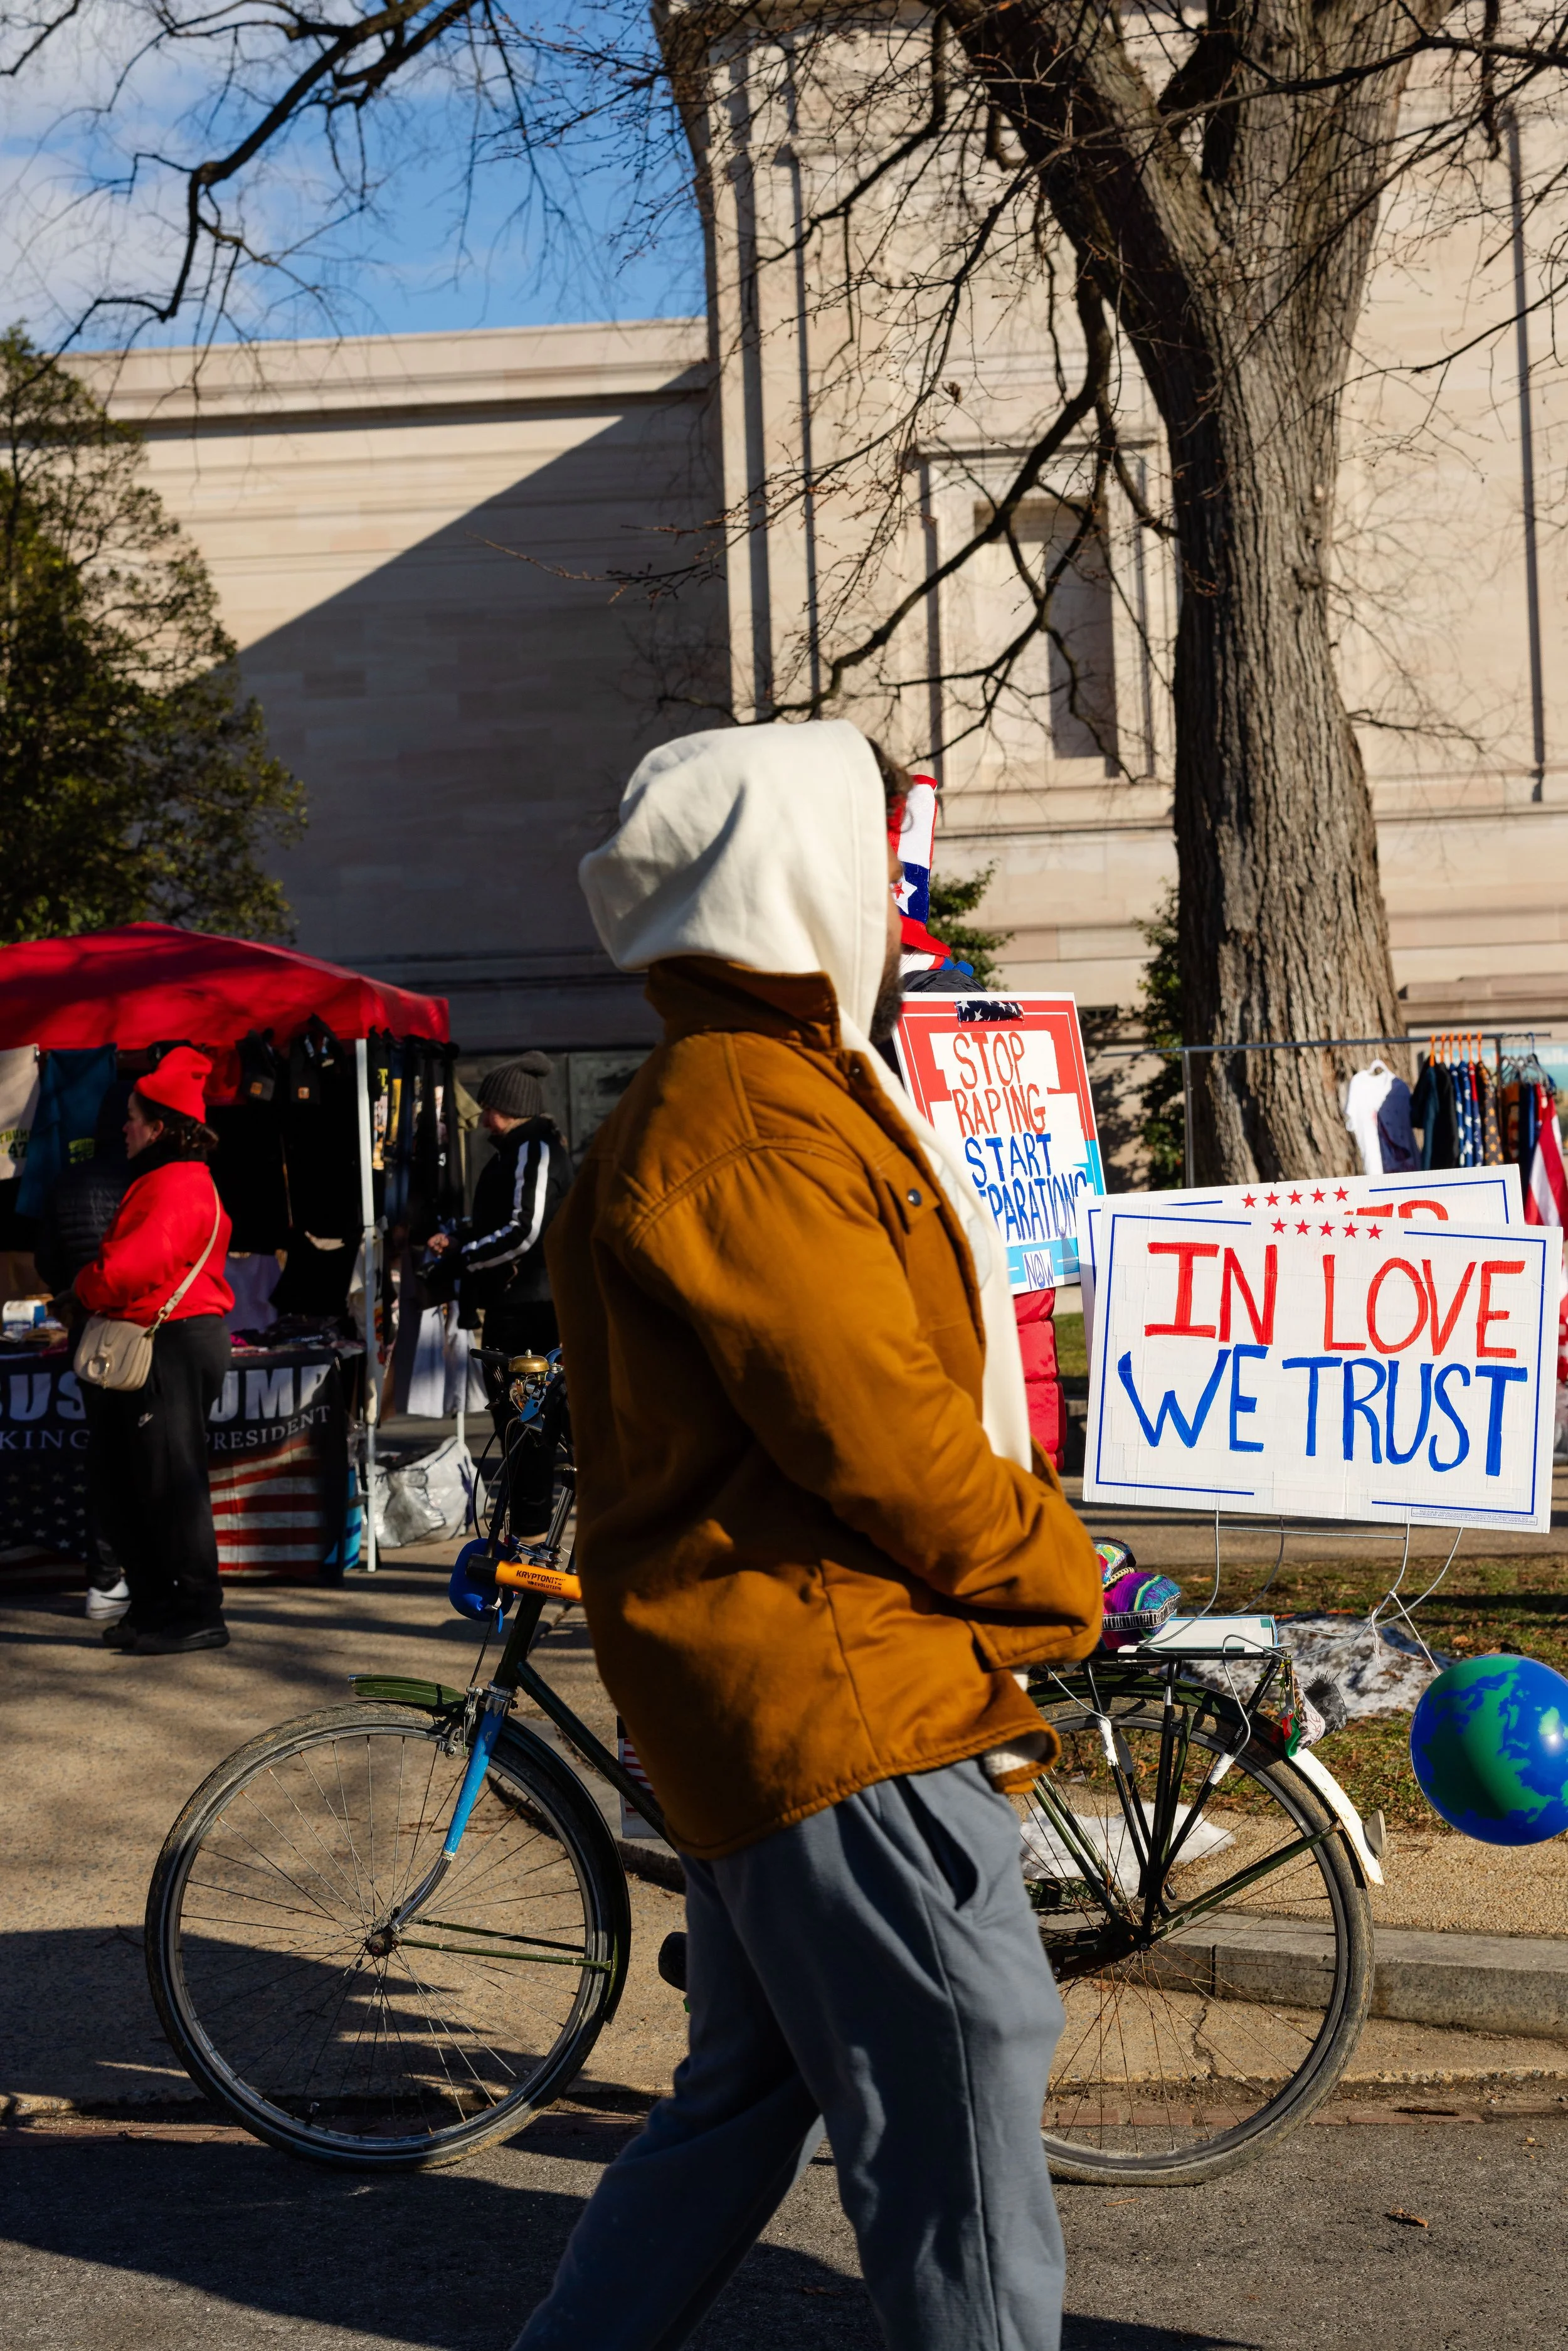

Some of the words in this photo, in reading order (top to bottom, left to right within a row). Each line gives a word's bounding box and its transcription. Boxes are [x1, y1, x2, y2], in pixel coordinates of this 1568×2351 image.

[953, 1031, 1024, 1090] STOP
[951, 1083, 1046, 1137] RAPING
[964, 1132, 1052, 1189] START
[978, 1170, 1088, 1243] PARATION
[1024, 1250, 1054, 1291] NOW
[1144, 1242, 1278, 1345] IN
[1323, 1255, 1526, 1358] LOVE
[1118, 1344, 1269, 1453] WE
[1282, 1357, 1528, 1477] TRUST
[534, 1581, 561, 1591] EVOLUTION
